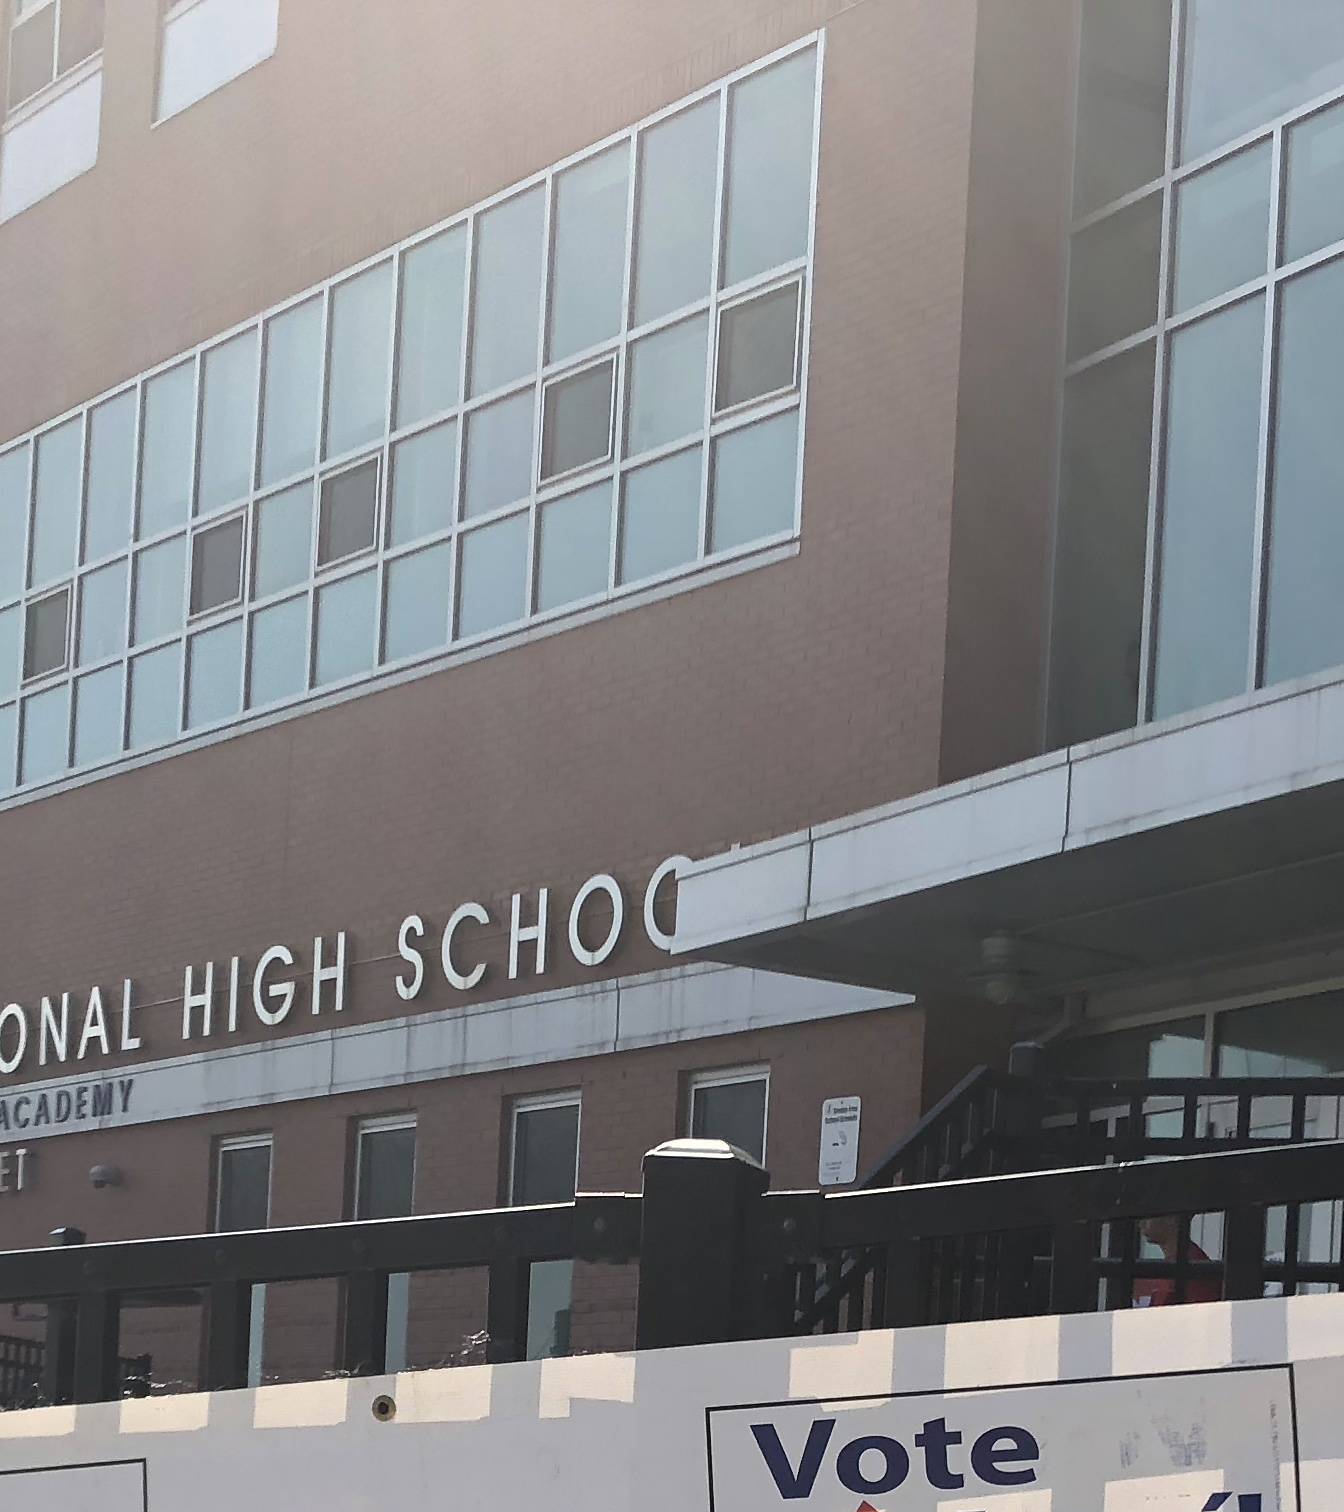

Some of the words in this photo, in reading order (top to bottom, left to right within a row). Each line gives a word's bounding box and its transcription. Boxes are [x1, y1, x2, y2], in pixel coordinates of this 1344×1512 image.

[181, 931, 346, 1040] HIGH
[394, 855, 694, 1001] SCHOO
[749, 1416, 1041, 1500] Vote
